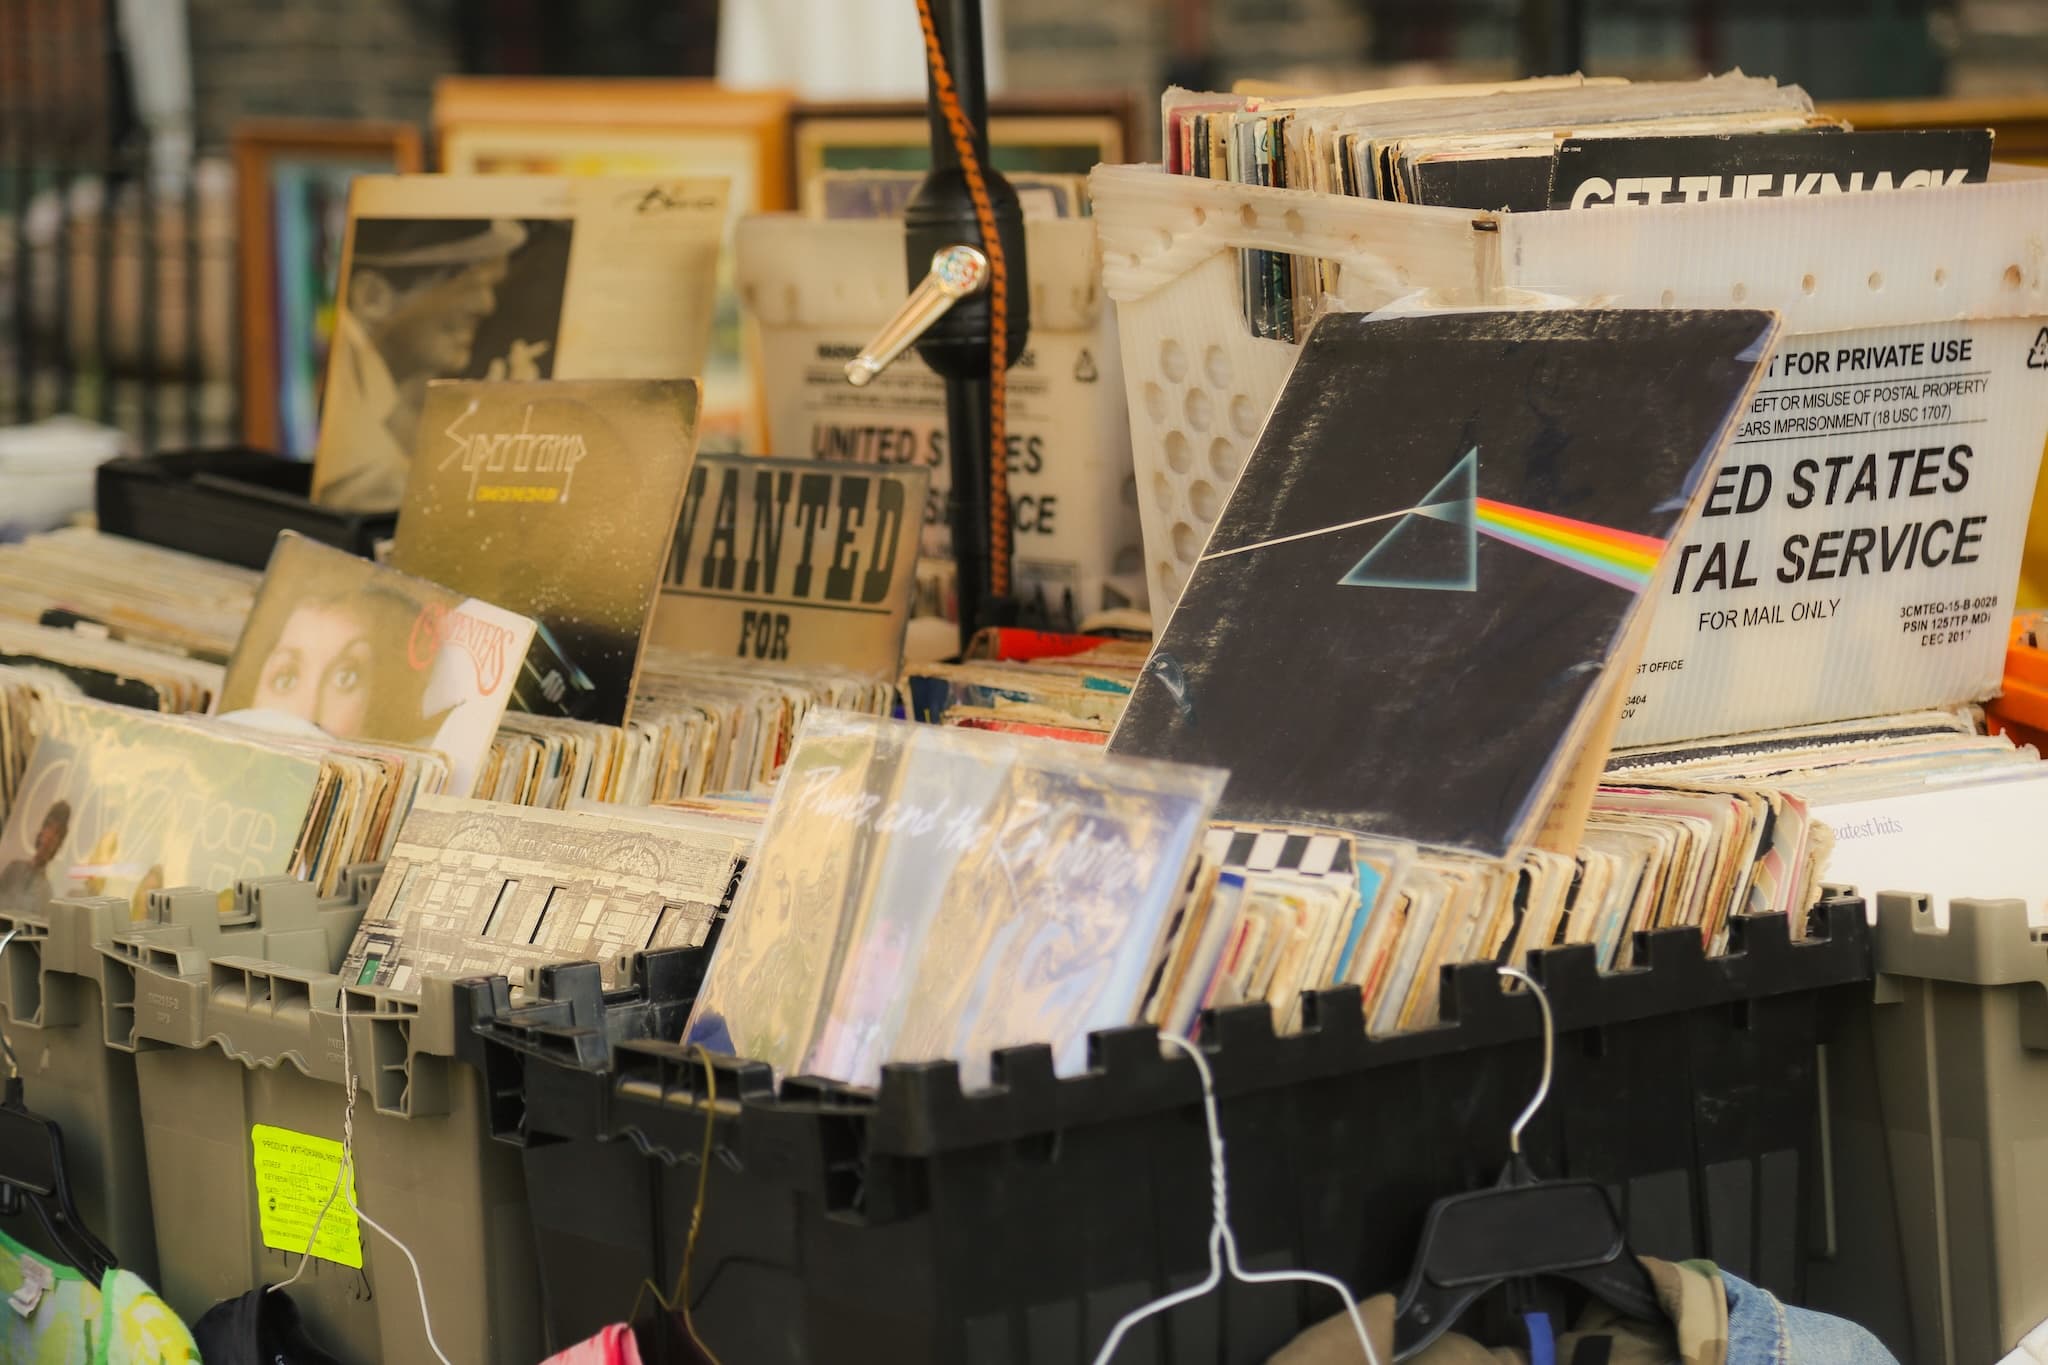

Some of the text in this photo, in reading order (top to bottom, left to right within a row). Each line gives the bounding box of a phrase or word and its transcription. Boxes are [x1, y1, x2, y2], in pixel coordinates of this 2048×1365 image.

[1784, 351, 1830, 376] FOR
[1836, 343, 1925, 372] PRIVATE
[1931, 339, 1973, 364] USE
[1780, 395, 1801, 411] OR
[1803, 391, 1851, 409] MISUSE
[1853, 389, 1871, 405] OF
[1873, 385, 1920, 403] POSTAL
[1922, 378, 1989, 399] PROPERTY
[1774, 411, 1871, 434] IMPRISONMENT
[1872, 410, 1890, 429] (18
[1892, 407, 1919, 424] USC
[1921, 403, 1952, 421] 1707)
[811, 424, 916, 464] UNITED
[1786, 444, 1974, 510] STATES
[1776, 515, 1988, 584] SERVICE
[1698, 598, 1841, 632] FOR MAIL ONLY
[1903, 619, 1928, 633] PSIN
[737, 610, 791, 662] FOR
[1921, 632, 1945, 647] DEC
[1649, 659, 1684, 673] OFFICE
[1872, 816, 1904, 836] hits
